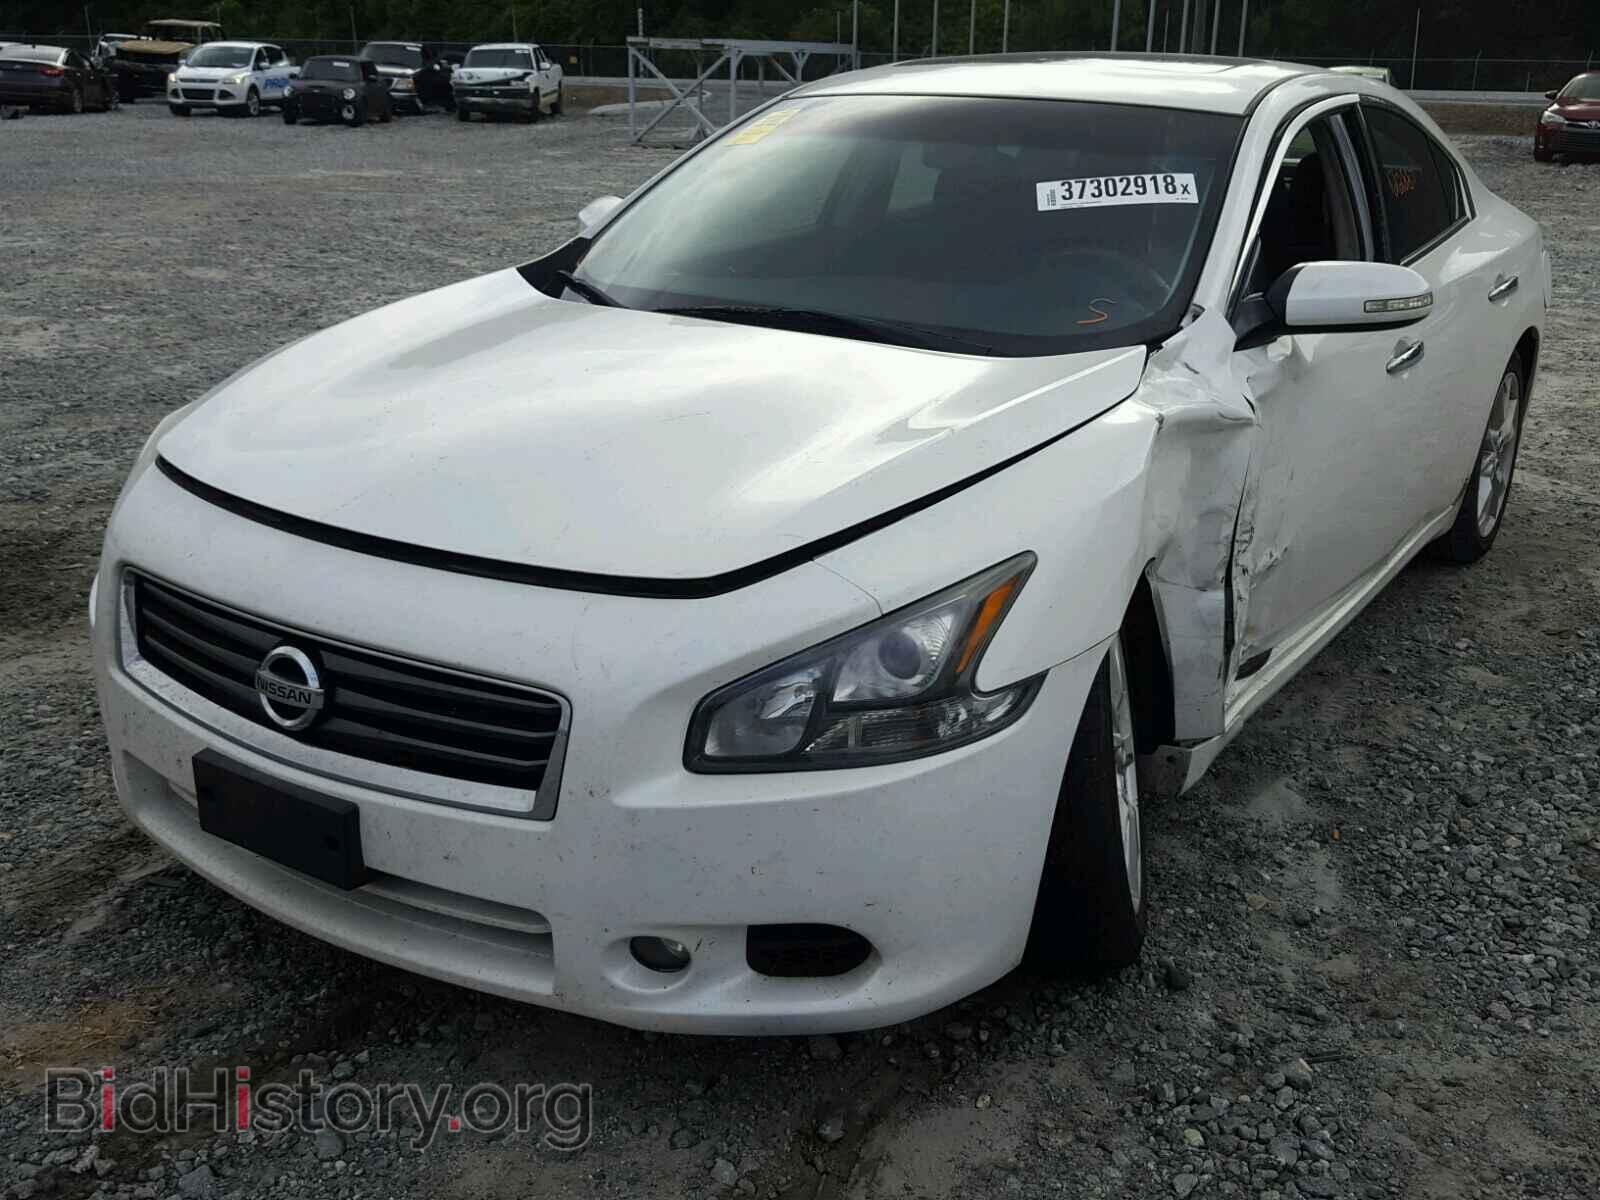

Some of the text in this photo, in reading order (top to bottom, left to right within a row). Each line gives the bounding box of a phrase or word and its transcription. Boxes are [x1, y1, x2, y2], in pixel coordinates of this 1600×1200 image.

[1060, 175, 1177, 201] 37302918
[1077, 297, 1116, 324] S
[257, 677, 312, 704] NISSAN
